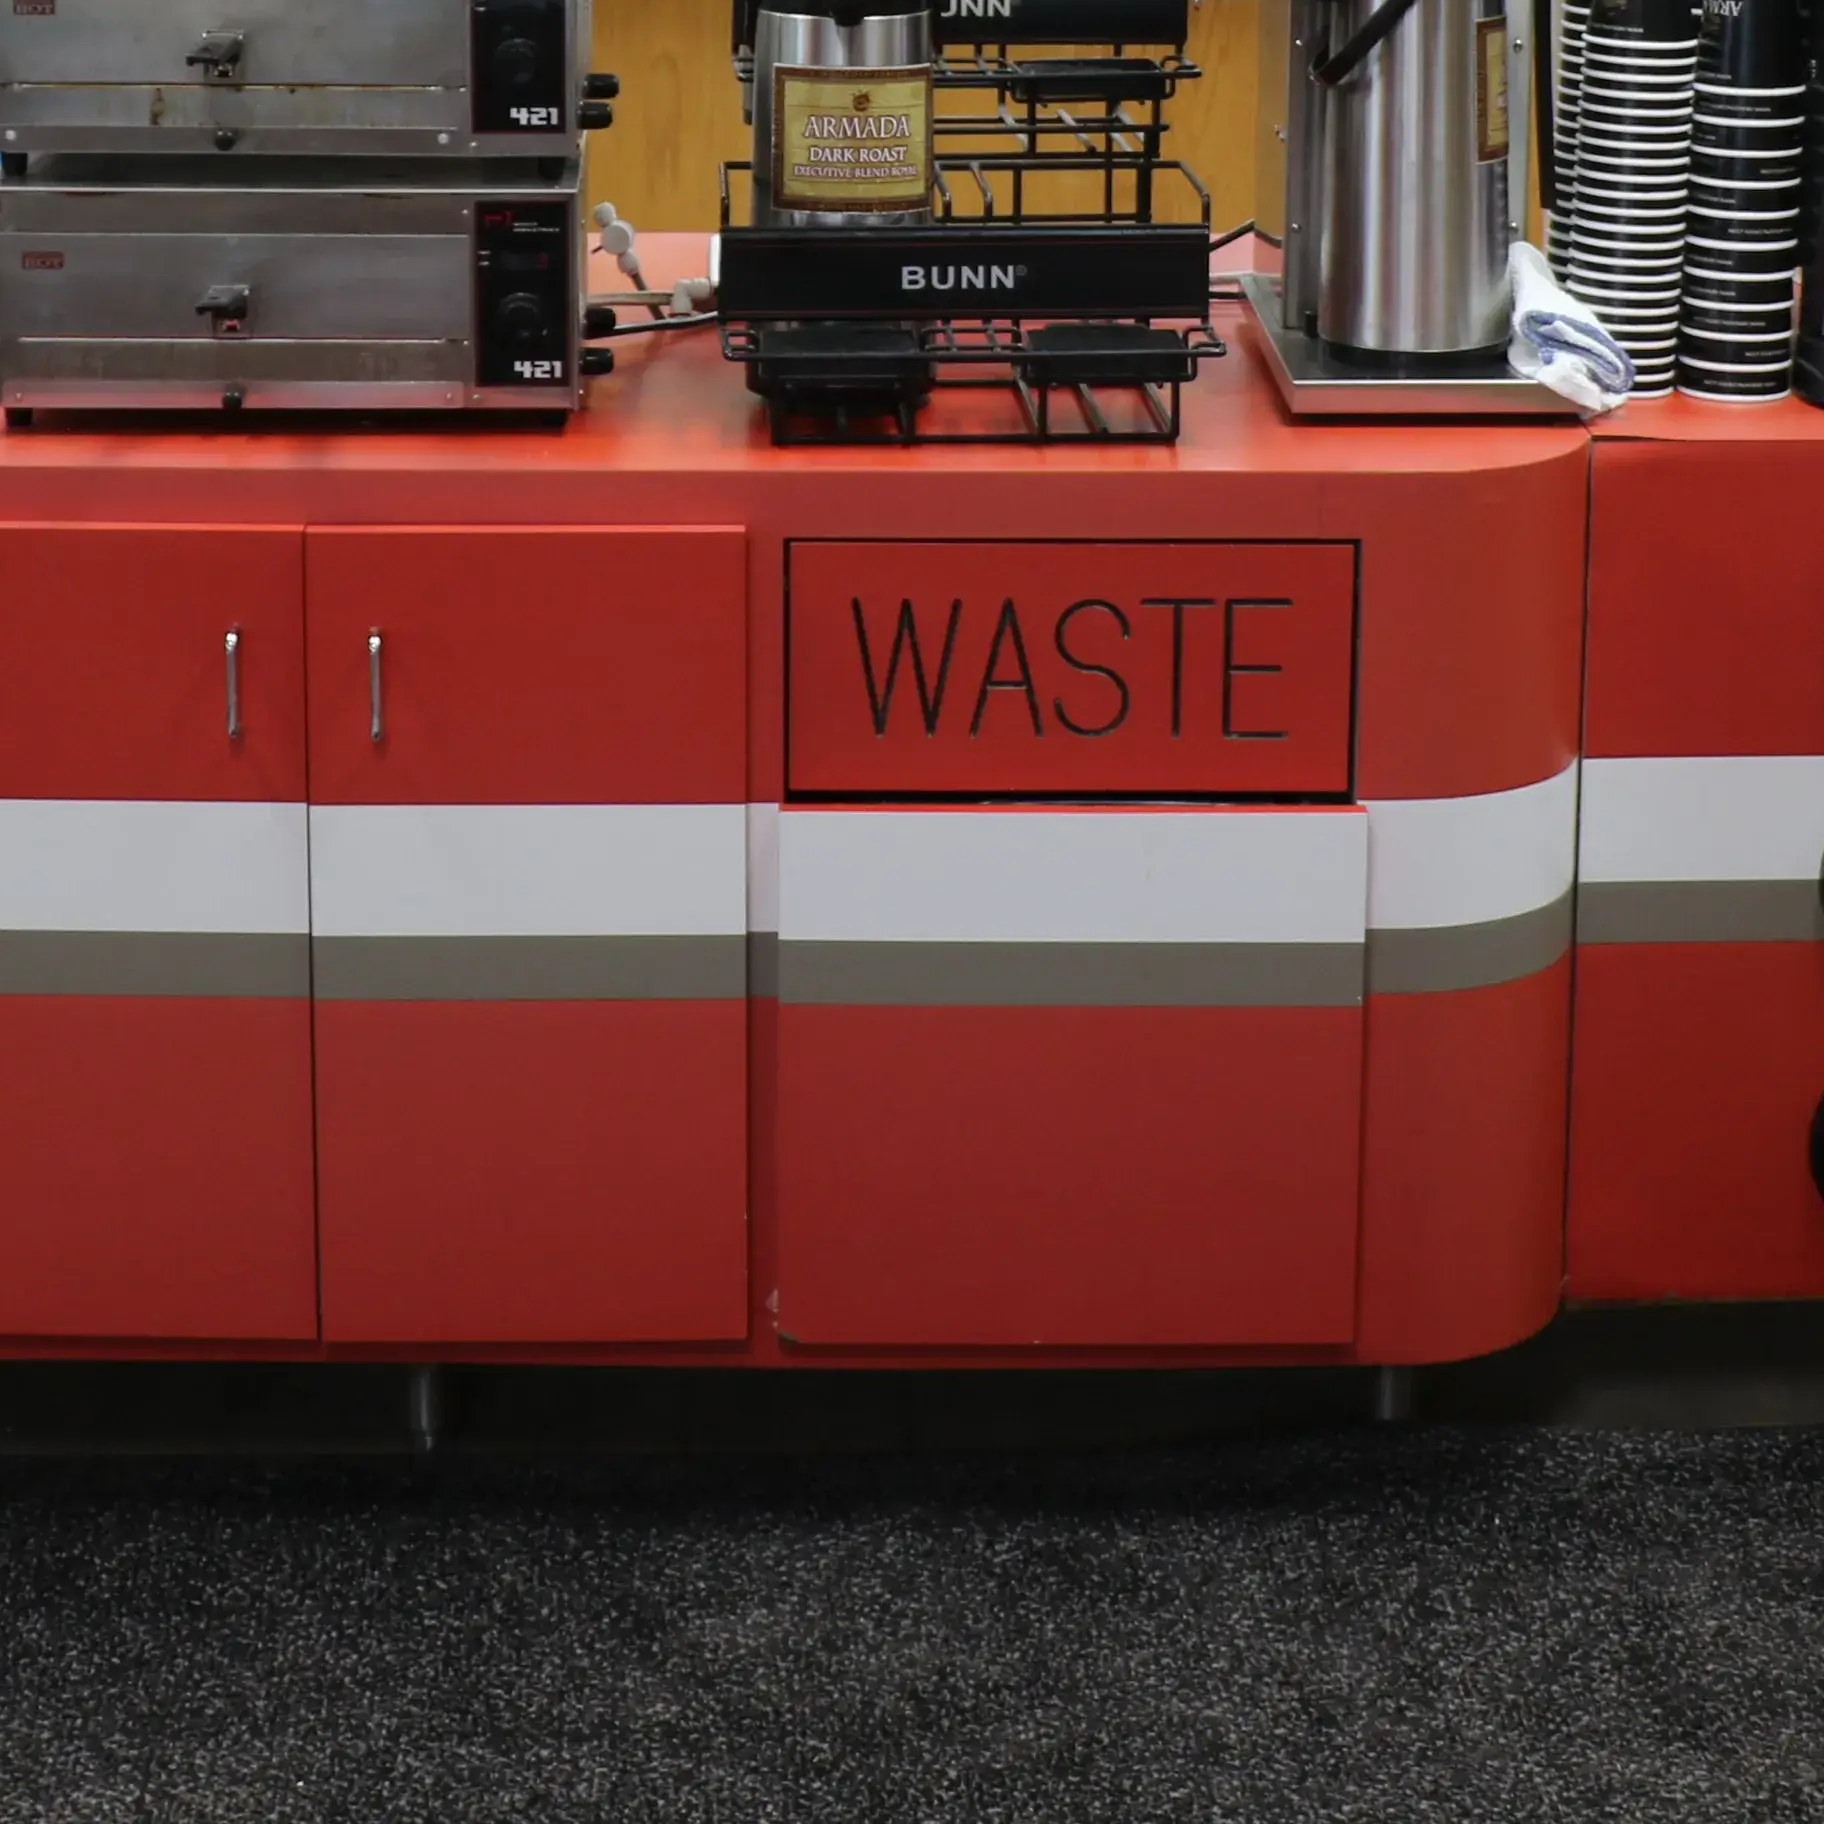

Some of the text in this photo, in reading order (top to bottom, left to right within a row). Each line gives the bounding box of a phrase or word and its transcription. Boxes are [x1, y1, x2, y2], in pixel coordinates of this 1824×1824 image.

[509, 107, 559, 125] 421
[804, 115, 911, 139] ARMADA
[810, 146, 907, 163] DARK ROAST
[794, 165, 853, 177] EXECUTIVE
[855, 166, 890, 177] BLEND
[901, 265, 1016, 291] BUNN
[513, 361, 562, 378] 421
[851, 596, 1293, 739] WASTE
